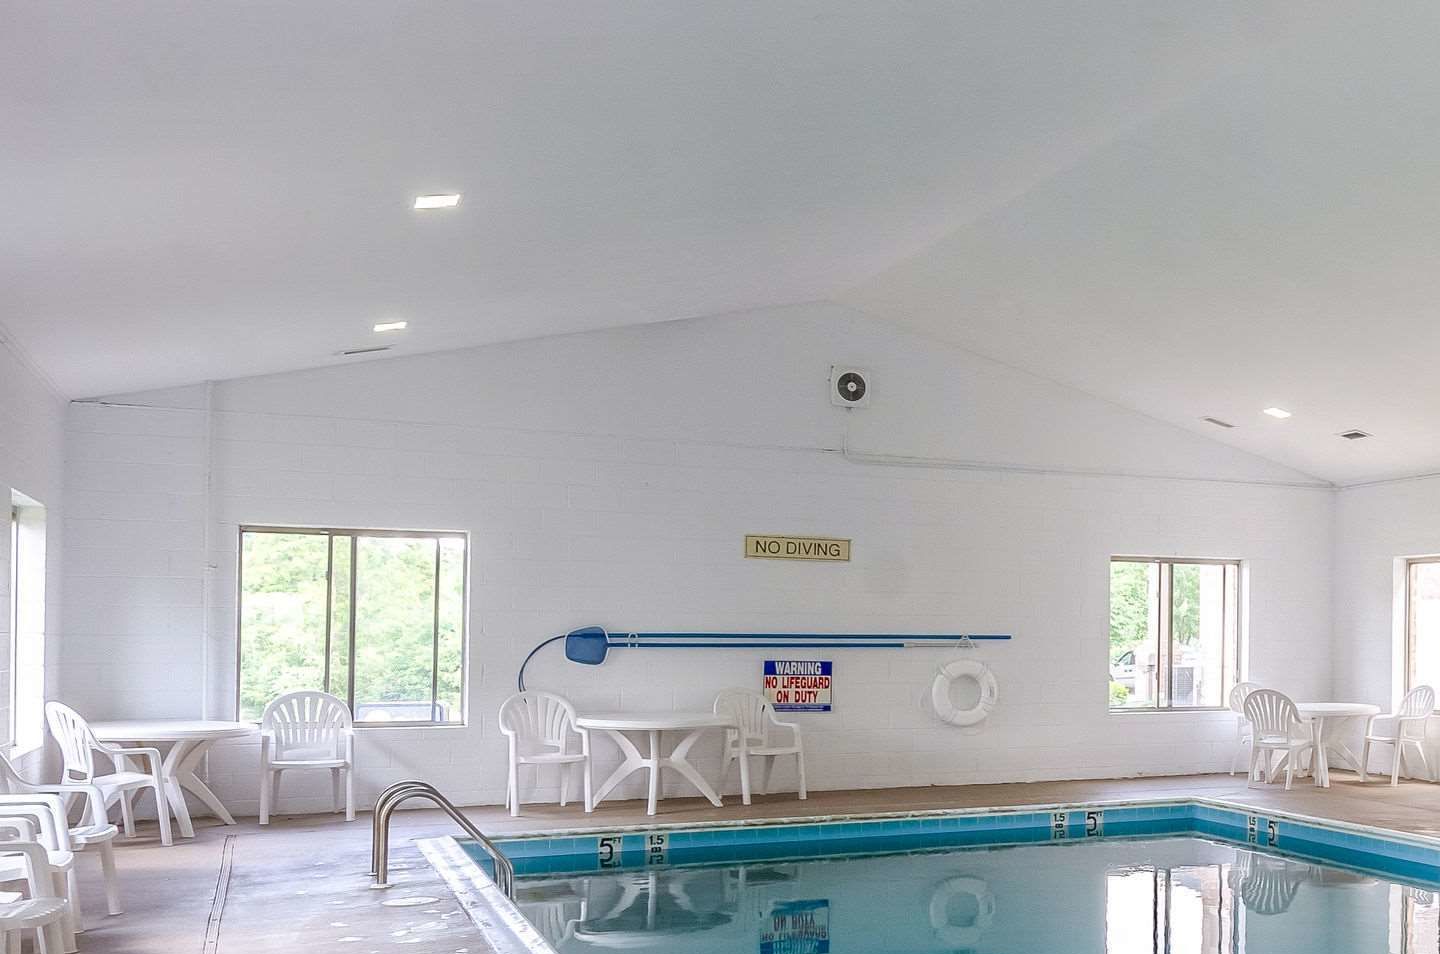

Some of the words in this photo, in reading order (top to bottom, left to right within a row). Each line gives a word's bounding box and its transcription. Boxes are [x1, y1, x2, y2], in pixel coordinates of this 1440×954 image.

[755, 540, 781, 554] NO
[786, 542, 841, 557] DIVING
[775, 661, 822, 675] WARNING
[765, 676, 777, 689] NO
[782, 676, 830, 689] LIFEGUARD
[776, 690, 789, 703] ON
[794, 690, 818, 703] DUTY
[1087, 811, 1097, 830] 5
[649, 834, 664, 845] 1.5
[599, 837, 614, 859] 5
